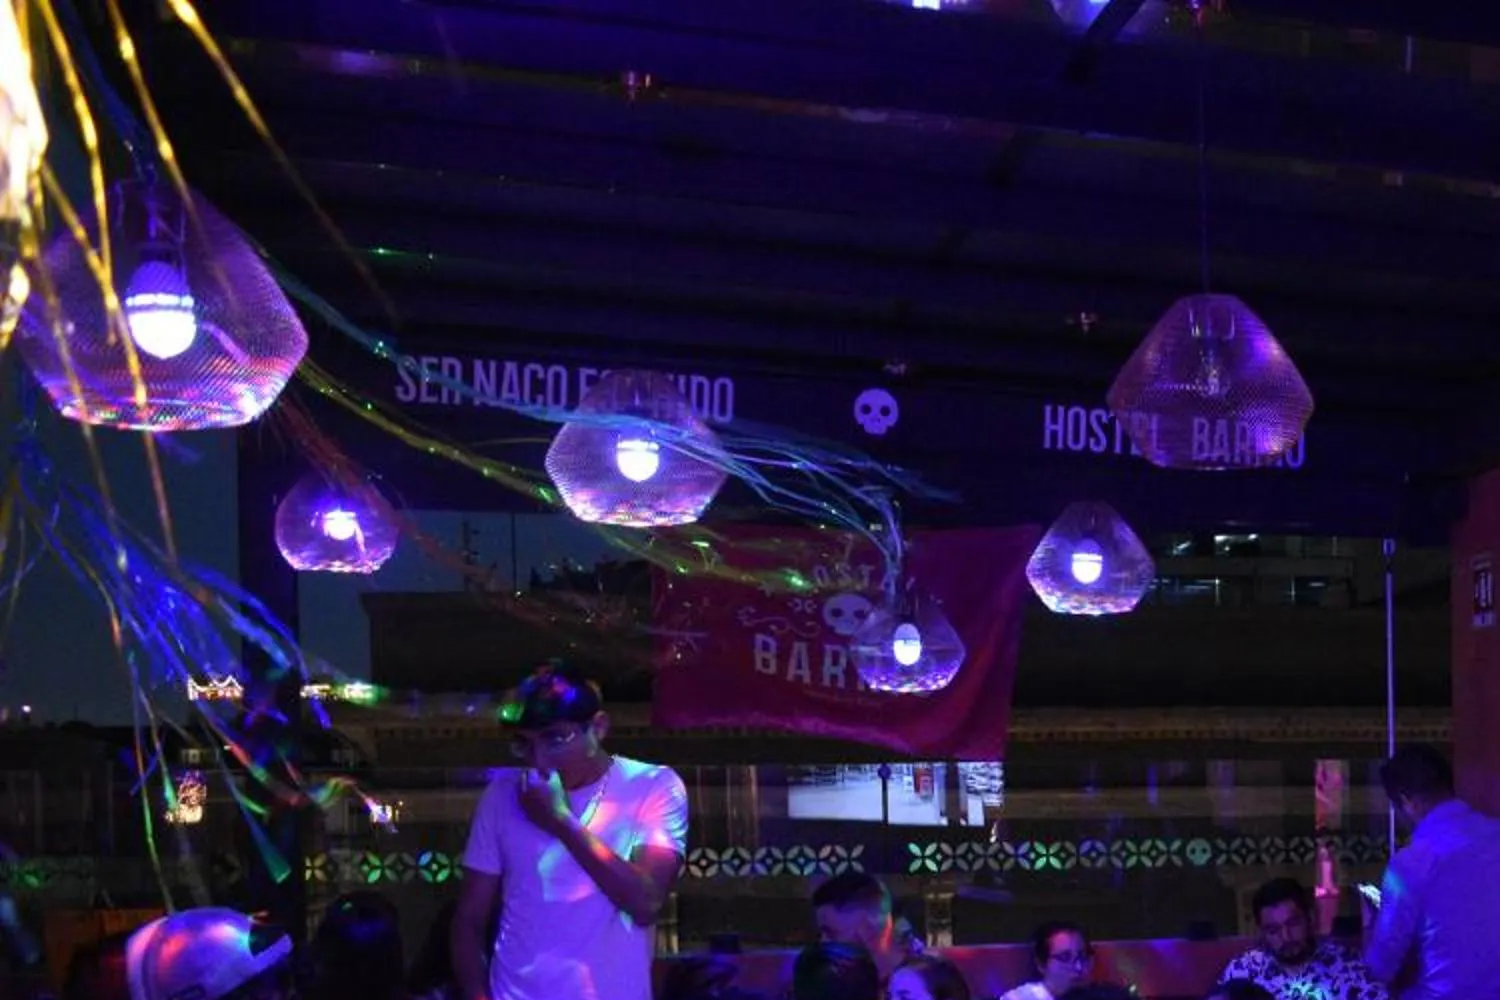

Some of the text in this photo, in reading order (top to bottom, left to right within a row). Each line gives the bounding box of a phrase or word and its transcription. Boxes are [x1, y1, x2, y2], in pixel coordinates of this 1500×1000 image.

[394, 354, 462, 405] SER
[472, 357, 568, 411] NACO
[1191, 415, 1307, 469] BARO
